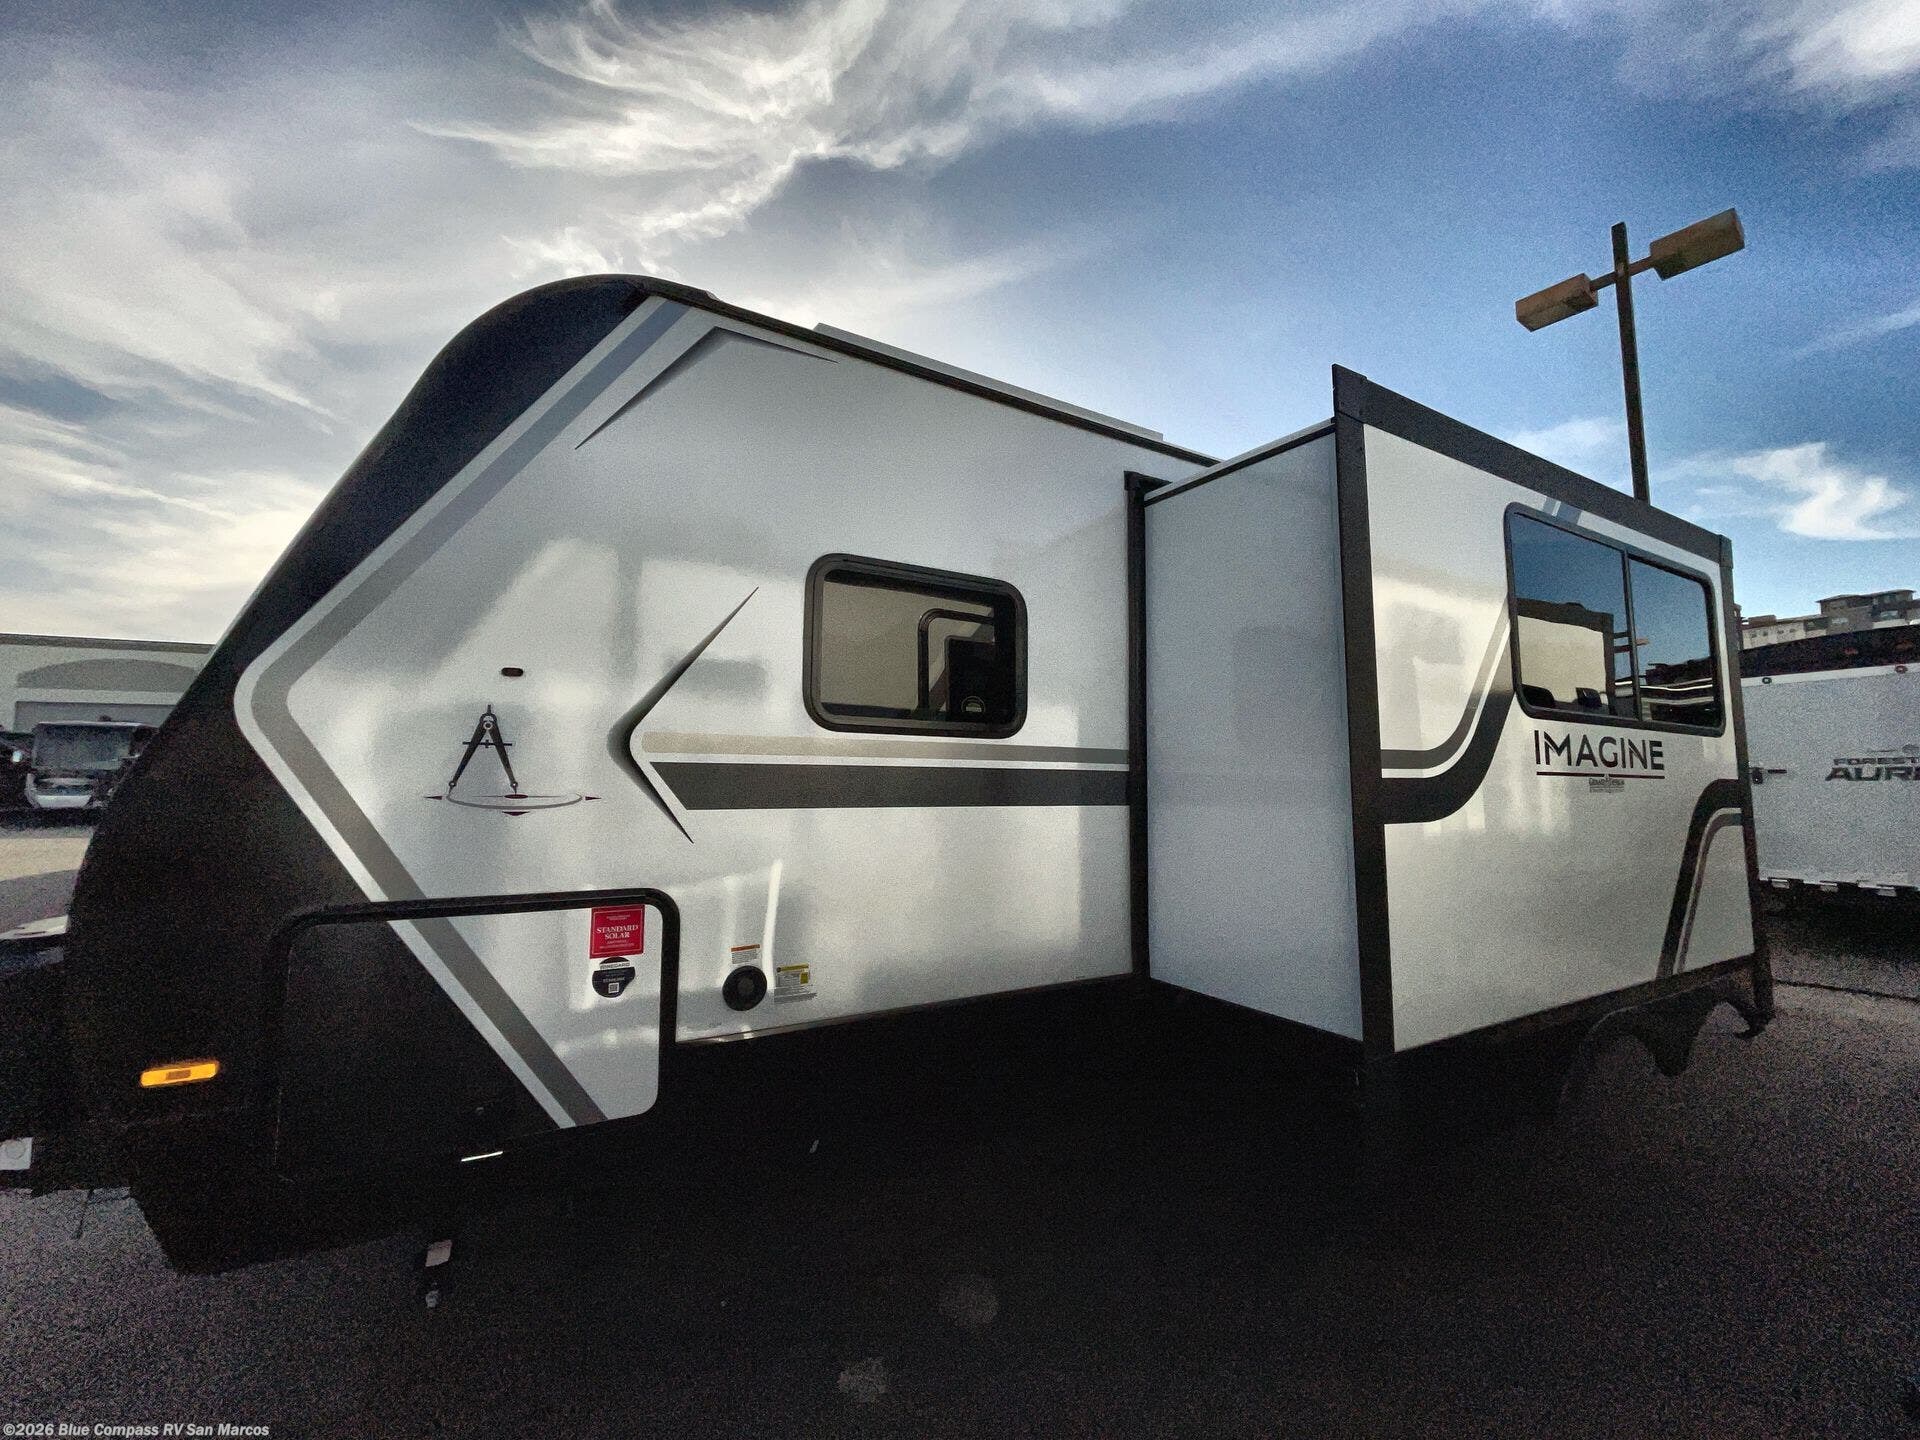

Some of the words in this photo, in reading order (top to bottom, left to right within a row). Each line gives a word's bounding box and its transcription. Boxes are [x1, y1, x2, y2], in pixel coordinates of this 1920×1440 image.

[1534, 730, 1665, 770] IMAGINE
[1825, 766, 1920, 781] AUR
[596, 925, 639, 934] STANDARD
[604, 931, 630, 940] SOLAR
